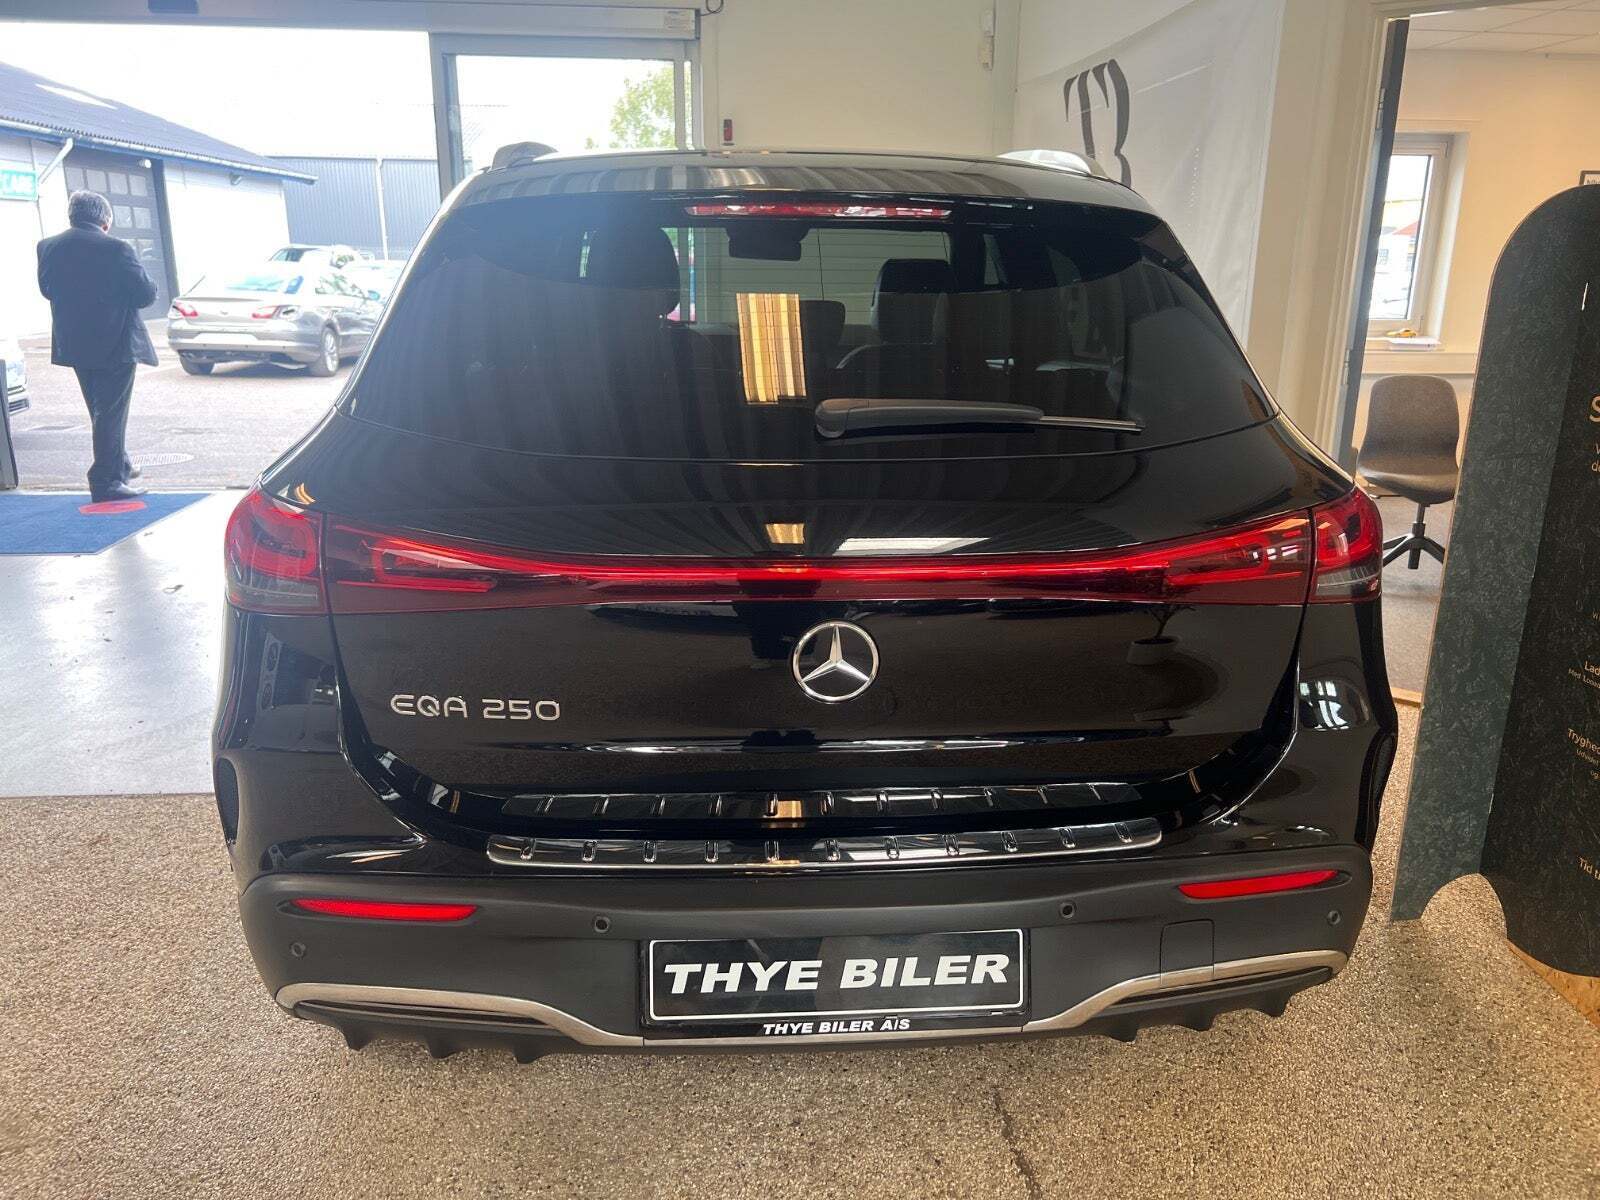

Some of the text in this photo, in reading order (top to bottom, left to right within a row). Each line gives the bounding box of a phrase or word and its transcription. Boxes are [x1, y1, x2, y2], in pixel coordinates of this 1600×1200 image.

[390, 694, 561, 721] EQA 250
[664, 954, 1010, 994] THYE BILER
[763, 1022, 813, 1035] THYE
[818, 1020, 874, 1033] BILER
